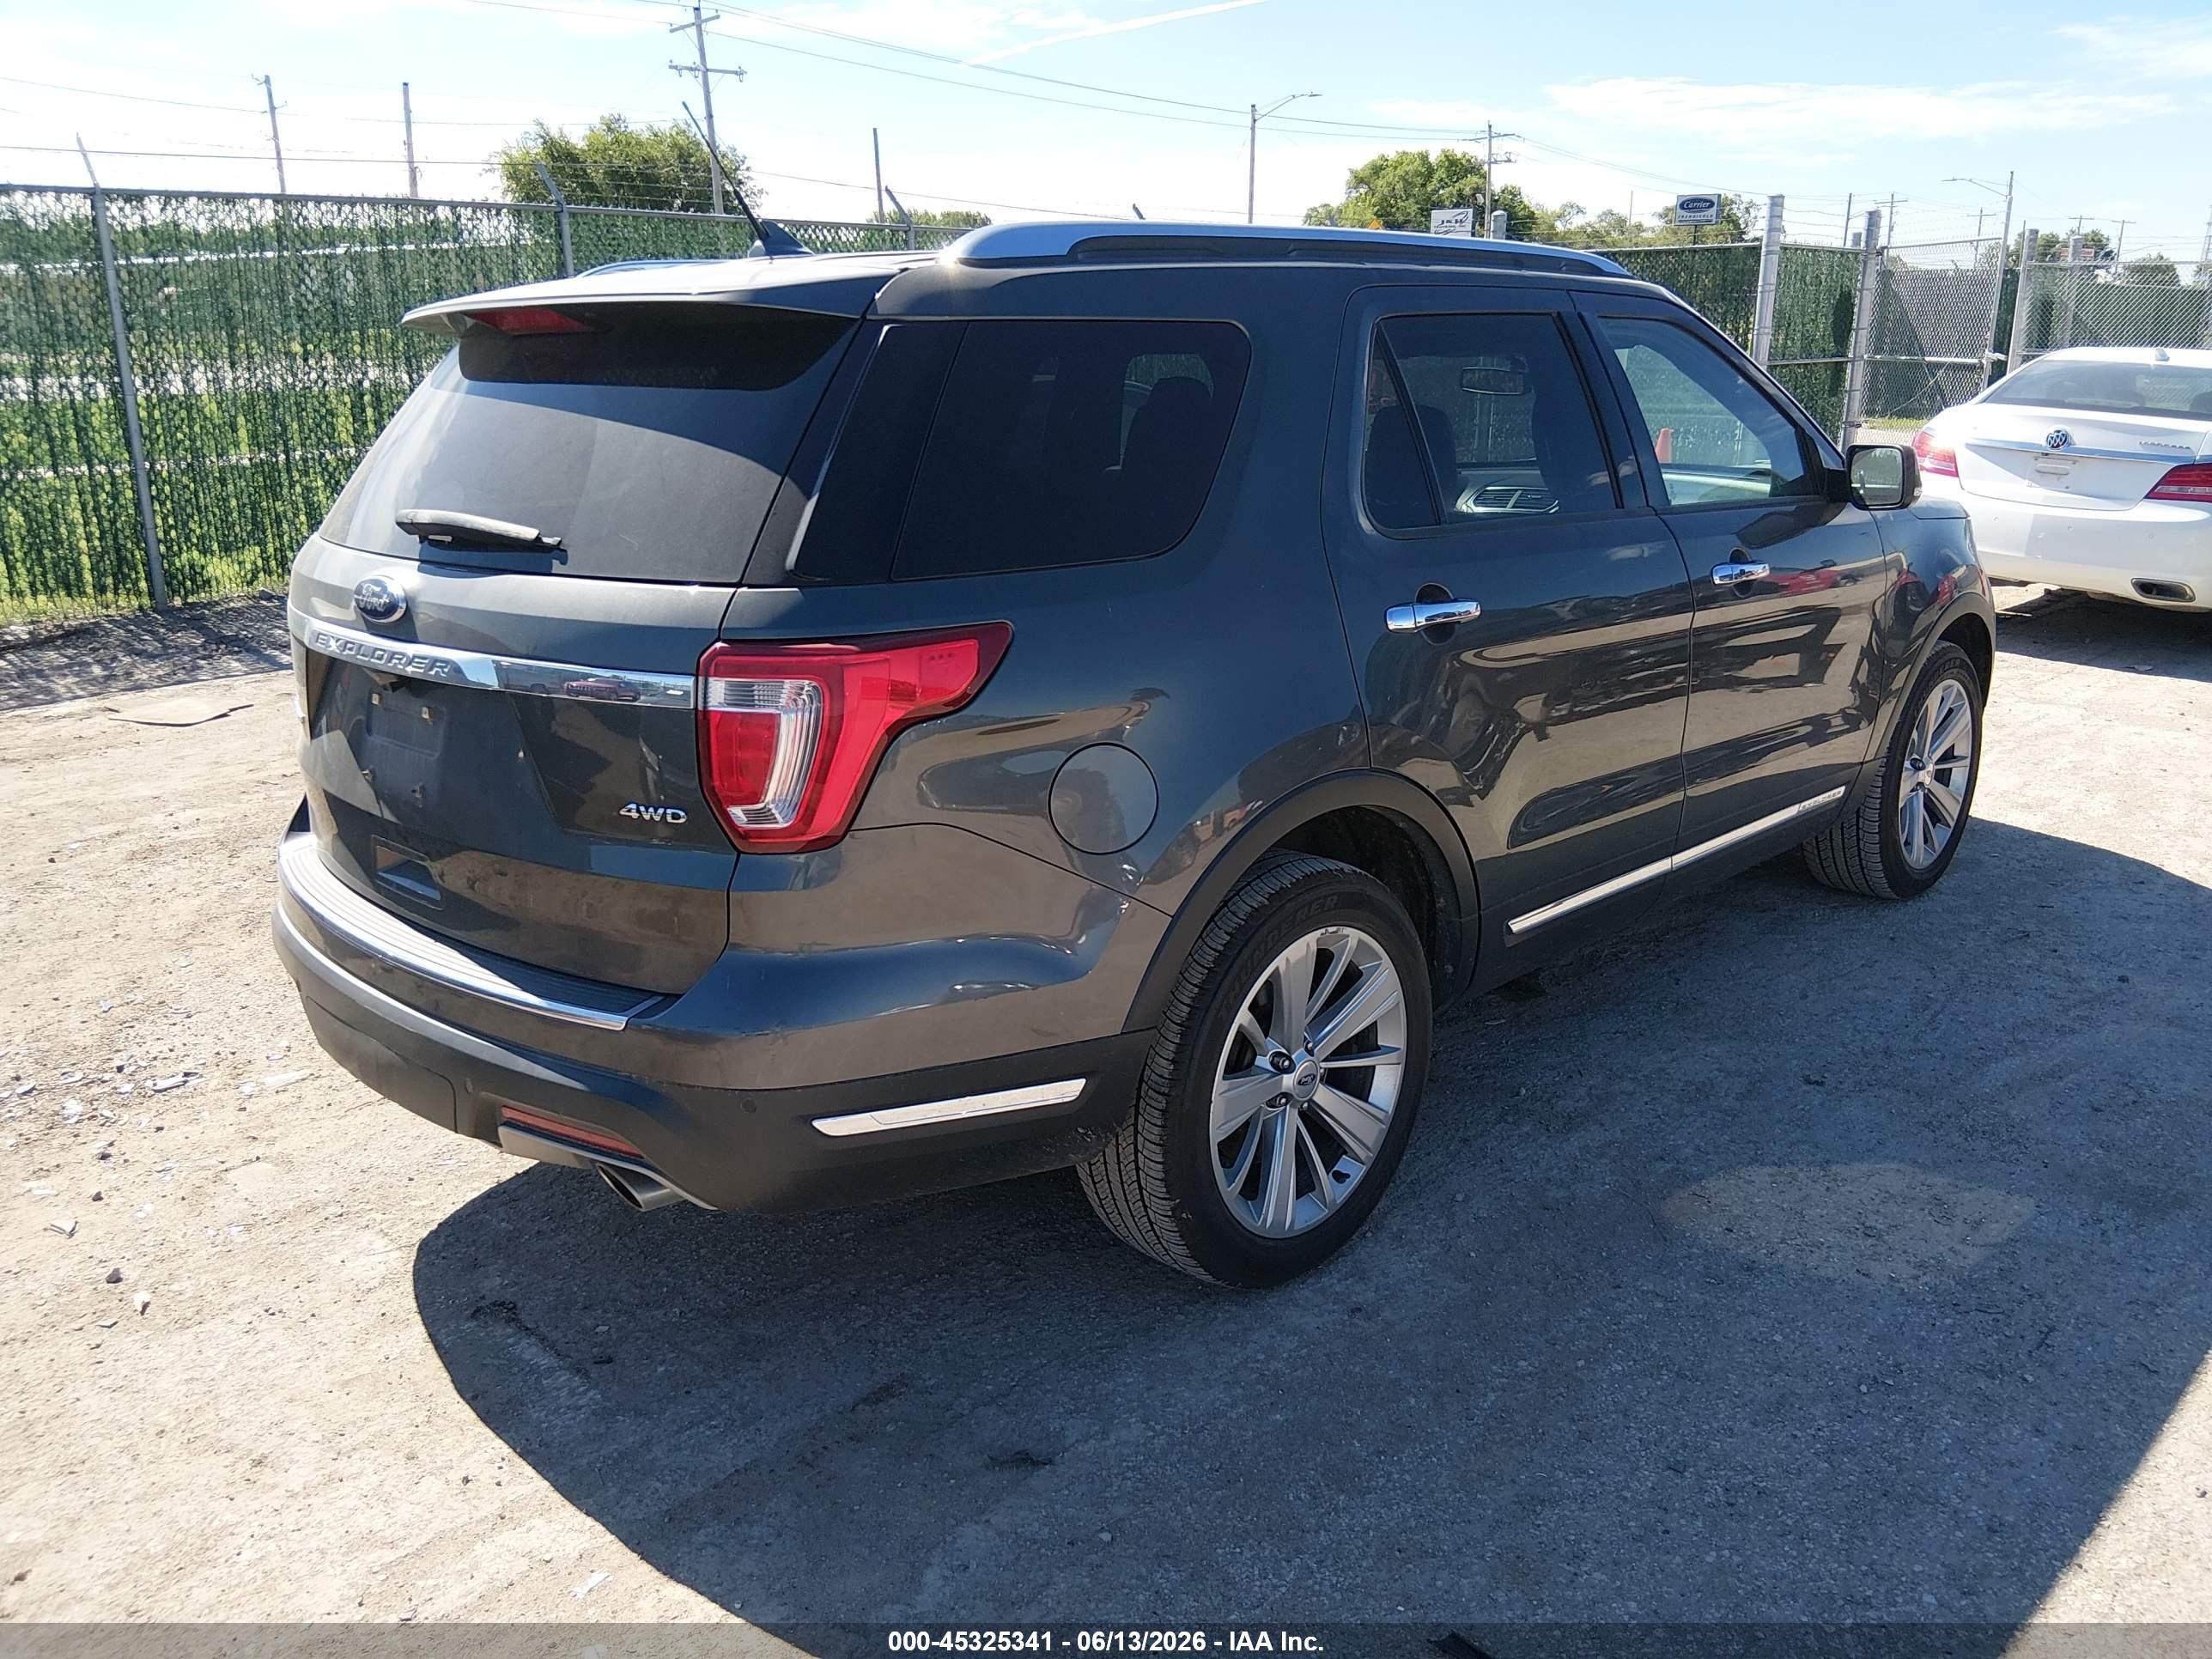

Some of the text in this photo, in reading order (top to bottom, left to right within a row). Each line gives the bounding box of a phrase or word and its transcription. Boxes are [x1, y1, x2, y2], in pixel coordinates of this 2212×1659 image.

[354, 583, 390, 612] Ford
[314, 632, 453, 678] EXPLORER
[619, 803, 688, 823] 4WD
